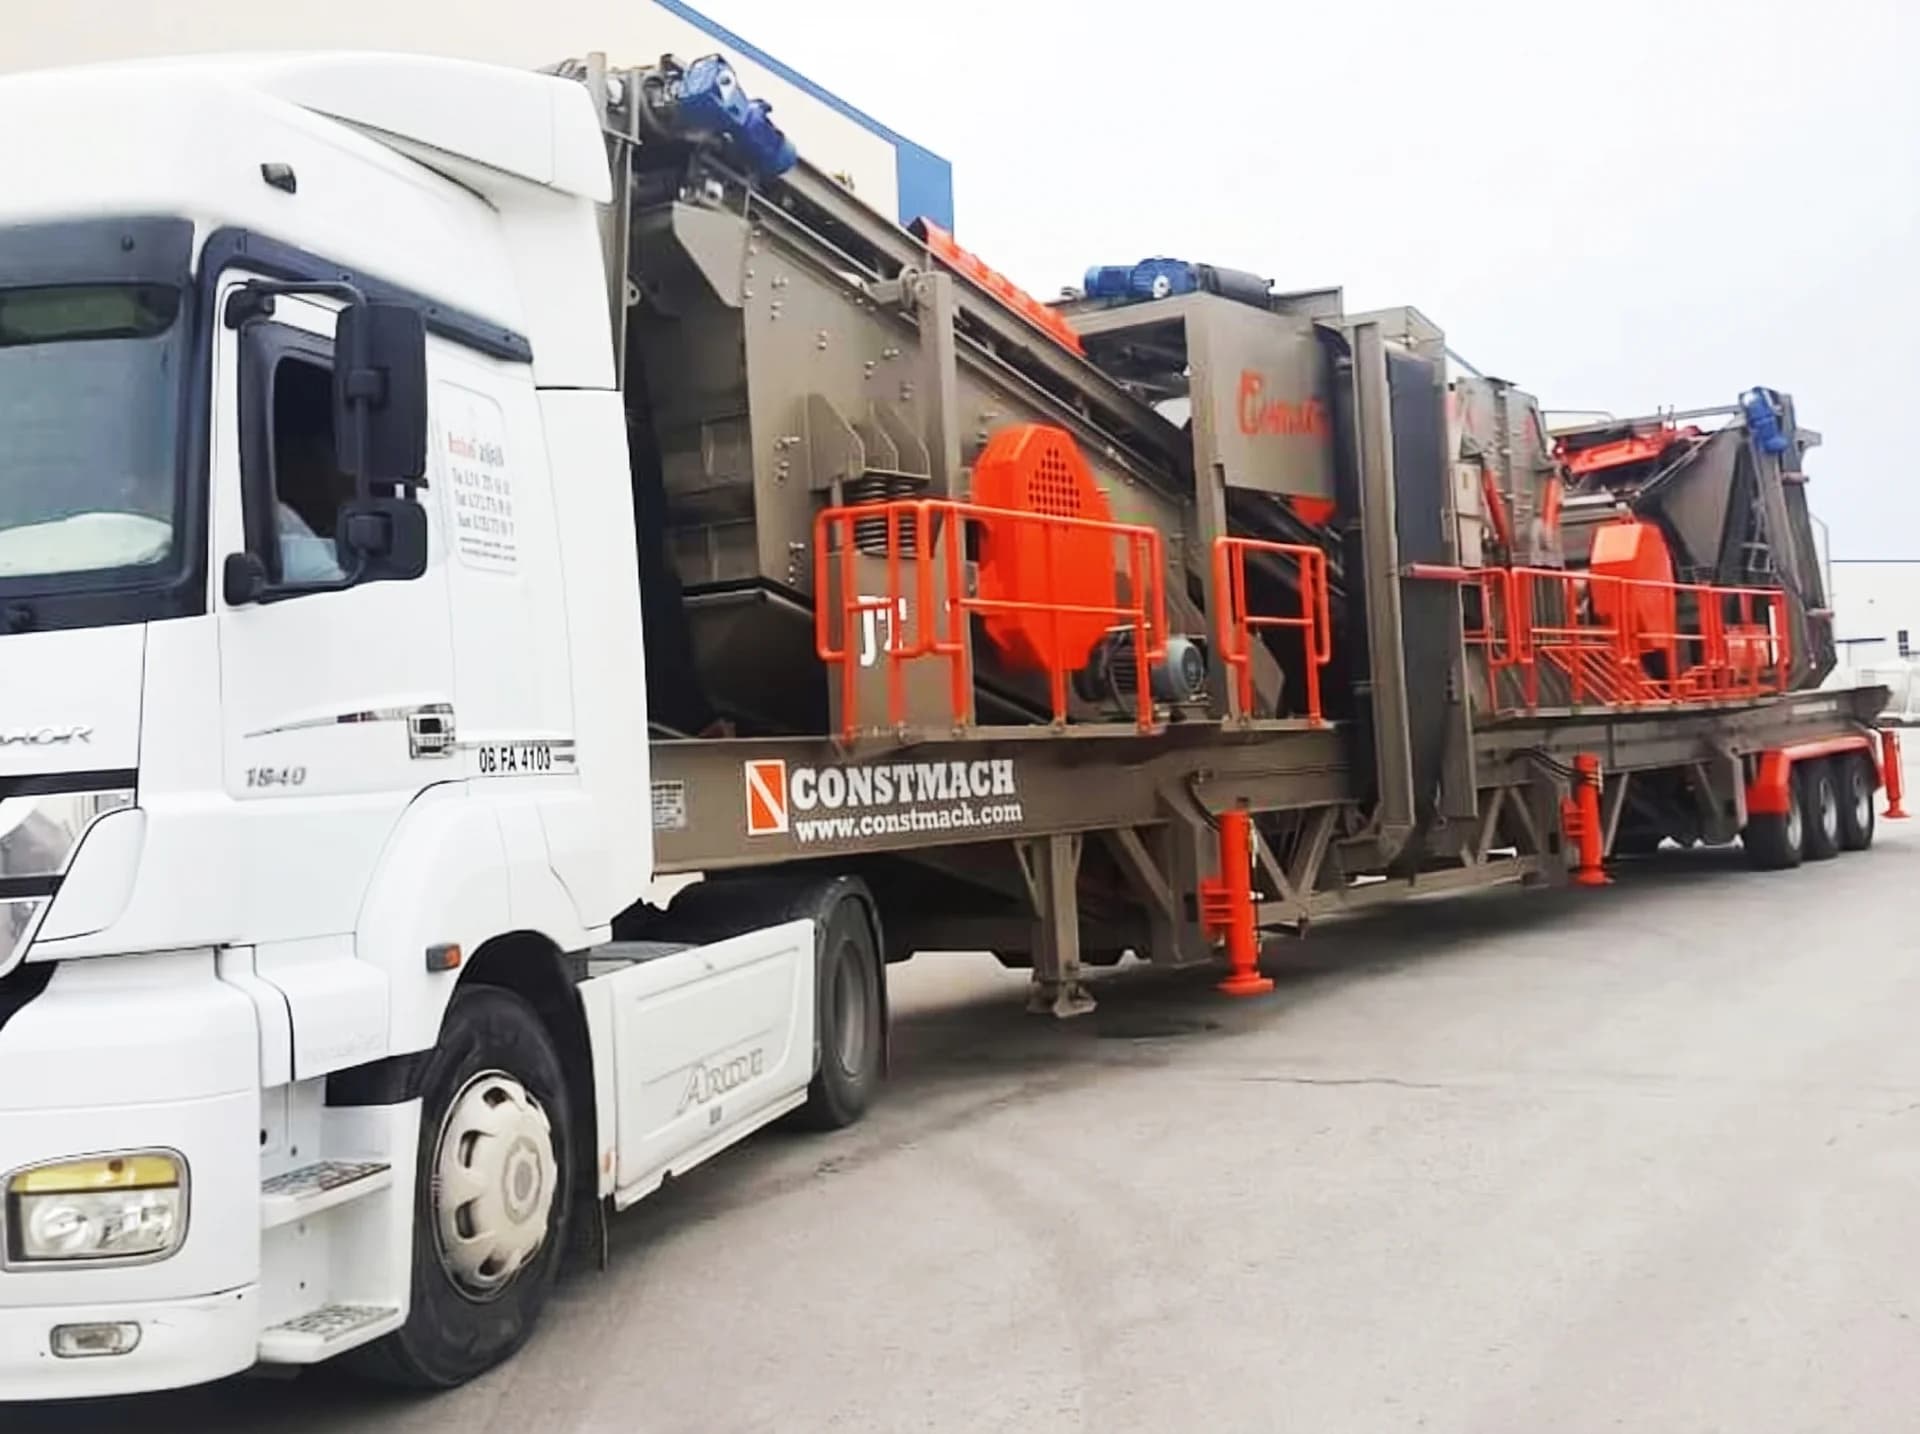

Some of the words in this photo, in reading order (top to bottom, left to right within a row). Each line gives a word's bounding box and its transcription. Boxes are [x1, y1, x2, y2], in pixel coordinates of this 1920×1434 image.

[500, 745, 517, 772] FA
[521, 744, 551, 772] 4103
[790, 759, 1016, 811] CONSTMACH
[795, 802, 1023, 842] www.constmach.com
